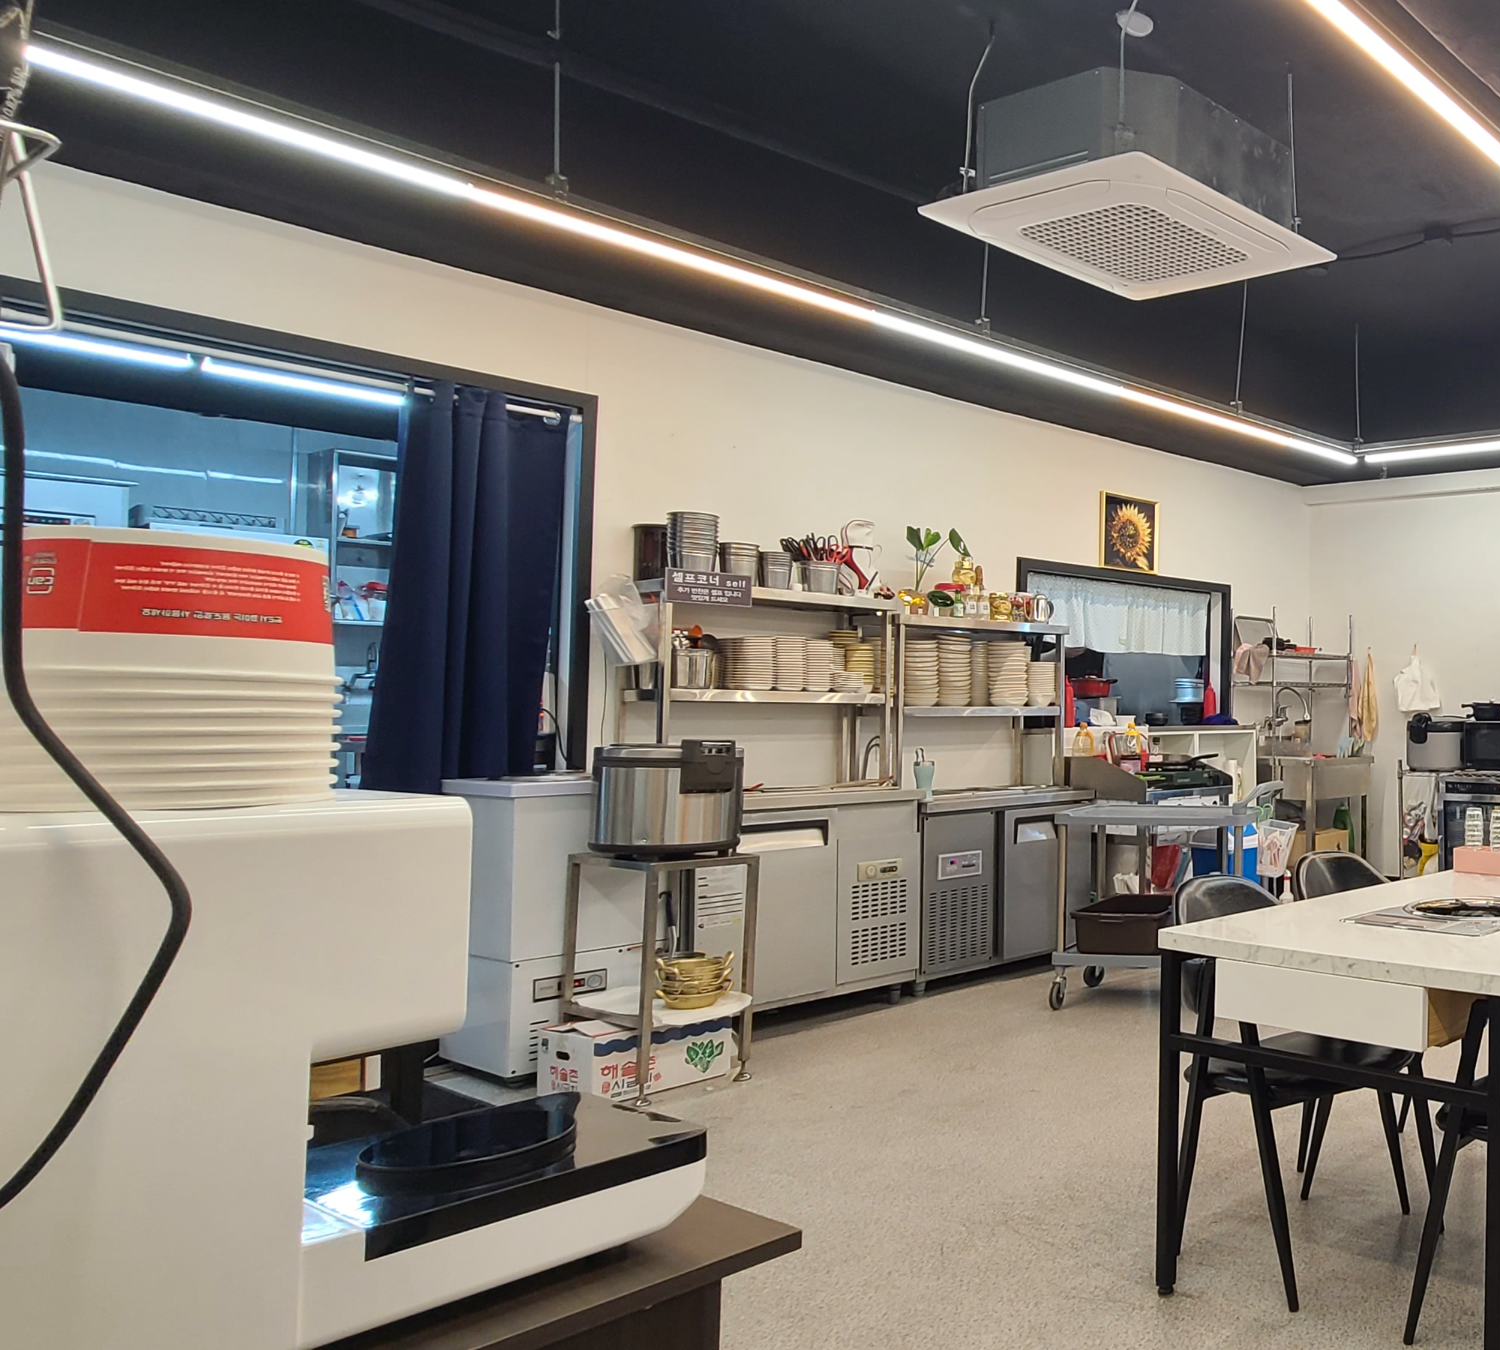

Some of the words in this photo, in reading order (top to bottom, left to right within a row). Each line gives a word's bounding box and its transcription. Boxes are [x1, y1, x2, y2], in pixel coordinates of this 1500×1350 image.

[672, 572, 719, 586] 셀프코너
[726, 580, 746, 588] self
[724, 590, 742, 598] 입니다
[141, 608, 190, 619] 사용하세요
